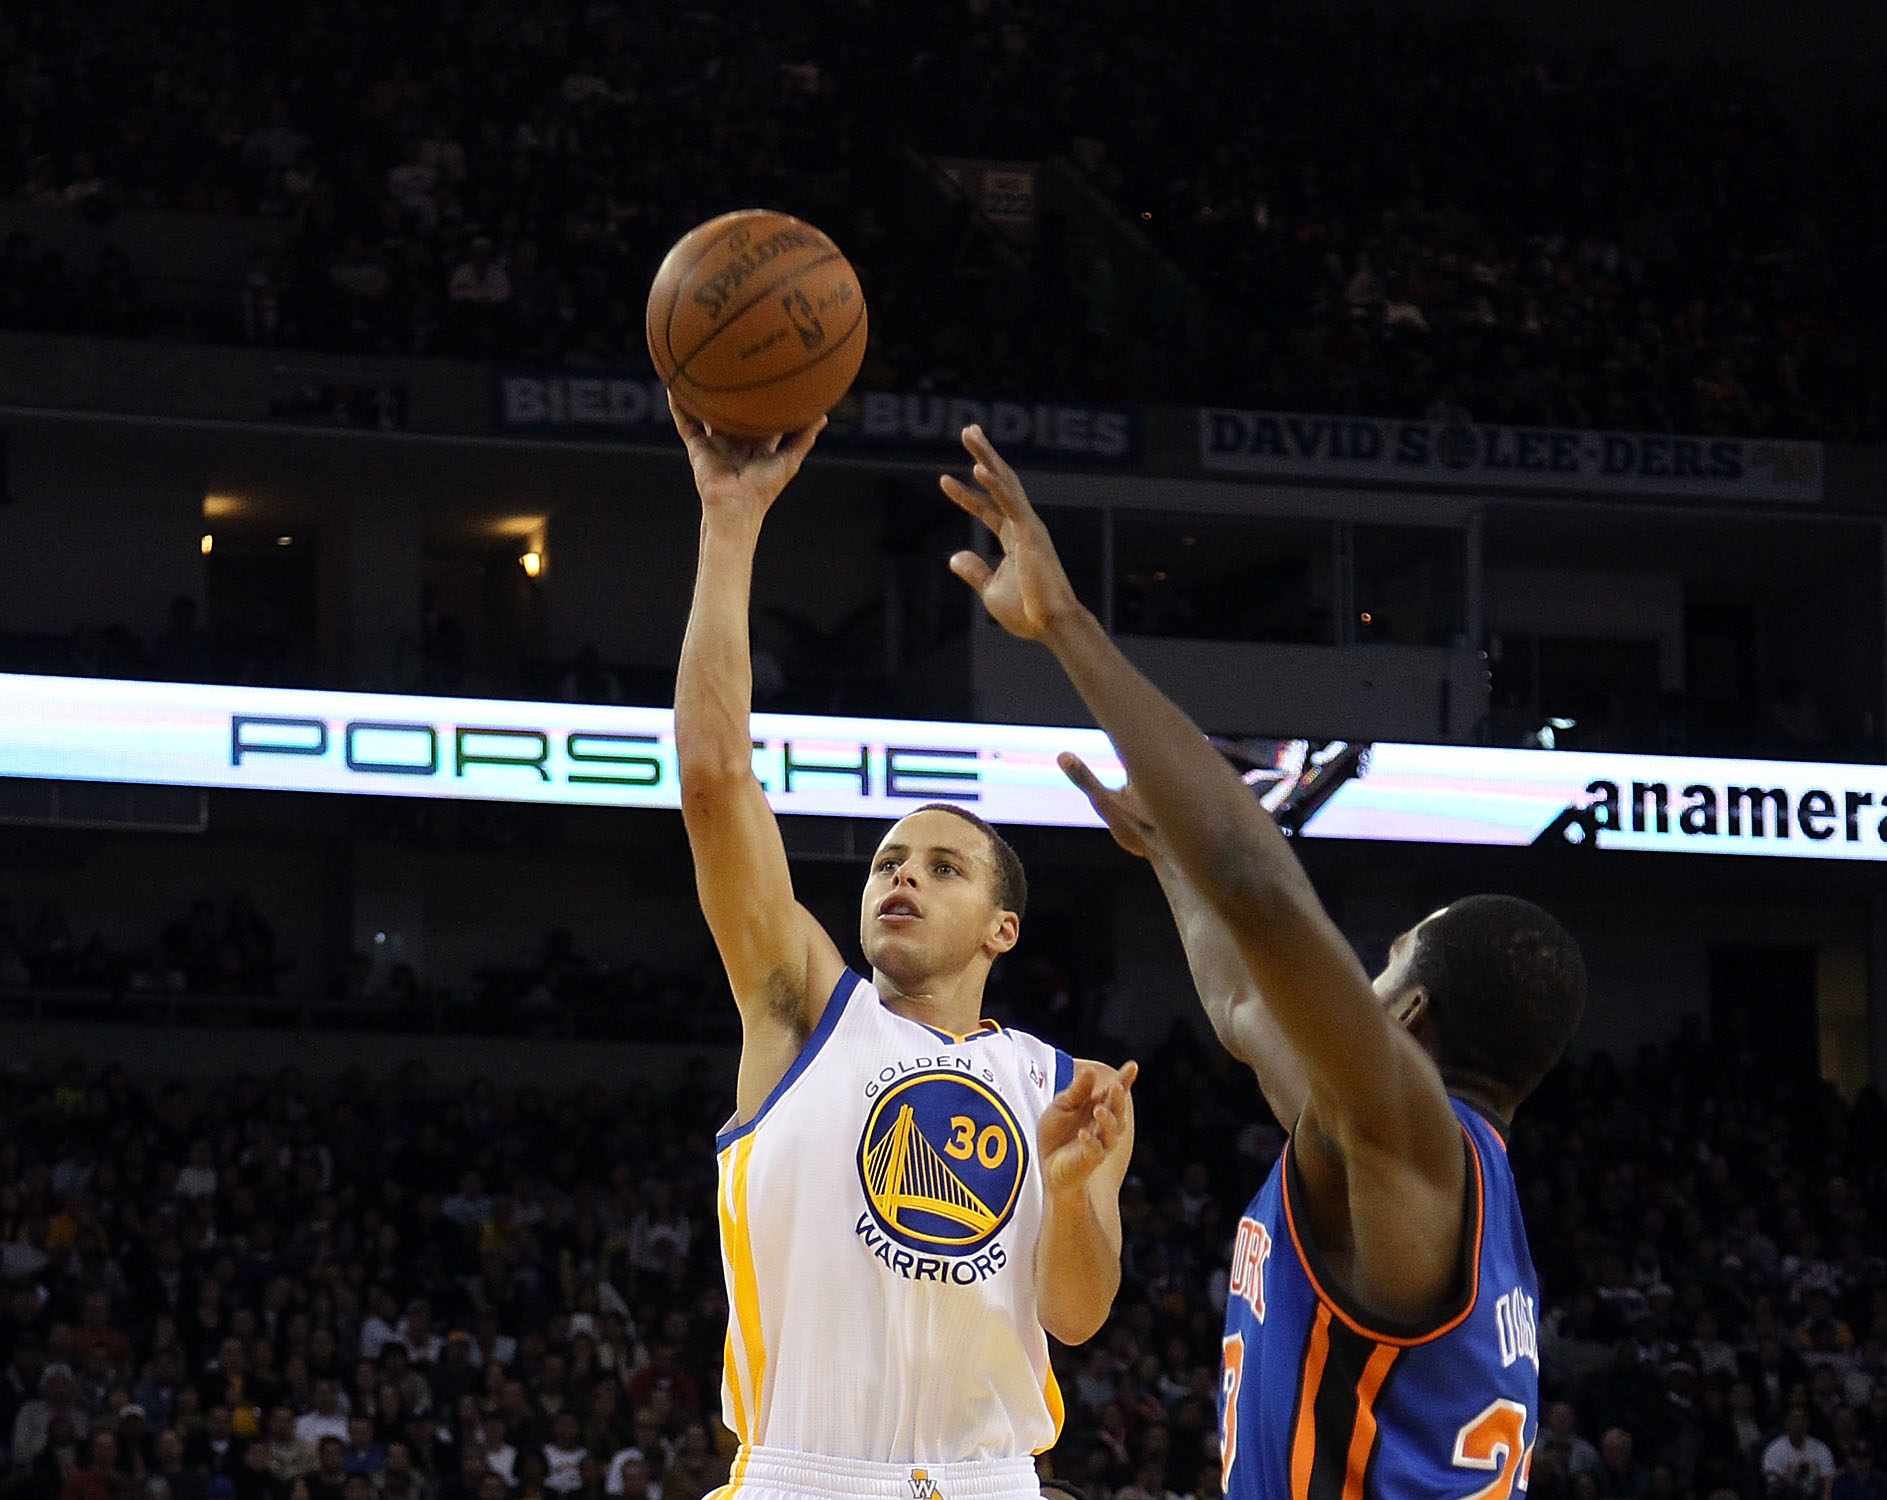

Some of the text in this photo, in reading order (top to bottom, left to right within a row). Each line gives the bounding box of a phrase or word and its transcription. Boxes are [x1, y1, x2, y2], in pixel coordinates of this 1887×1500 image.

[862, 390, 1129, 457] BUDDIES
[231, 713, 980, 801] PORSHE
[1585, 779, 1887, 843] anamer
[864, 1055, 972, 1099] GOLDEN
[943, 1115, 1008, 1170] 30
[855, 1211, 1008, 1286] WARRIORS
